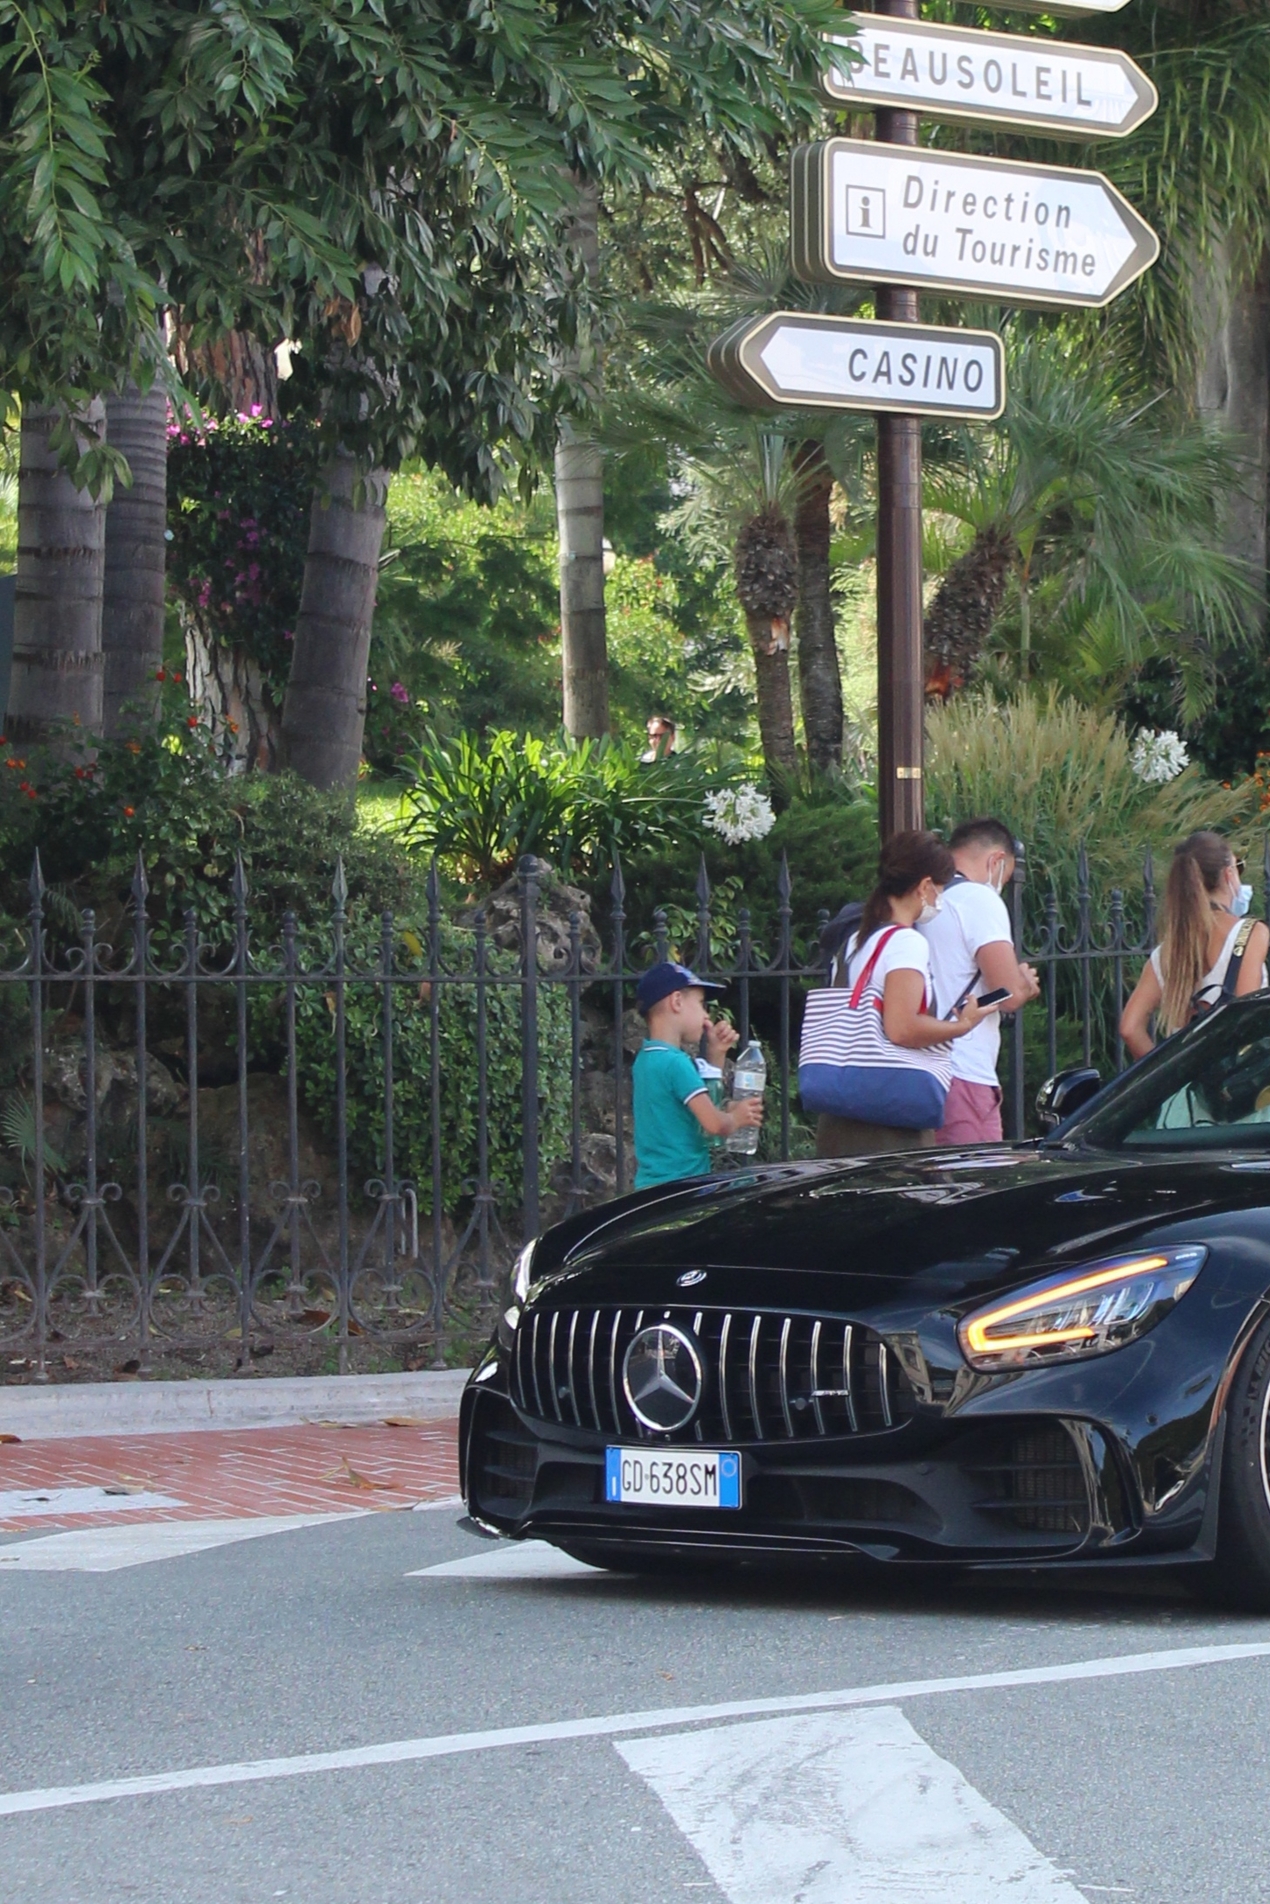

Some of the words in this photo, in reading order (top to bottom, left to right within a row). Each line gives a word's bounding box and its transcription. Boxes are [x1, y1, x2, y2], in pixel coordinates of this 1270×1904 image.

[902, 174, 1071, 229] Direction
[902, 223, 939, 259] du
[955, 227, 1097, 277] Tourisme
[848, 347, 984, 393] CASINO
